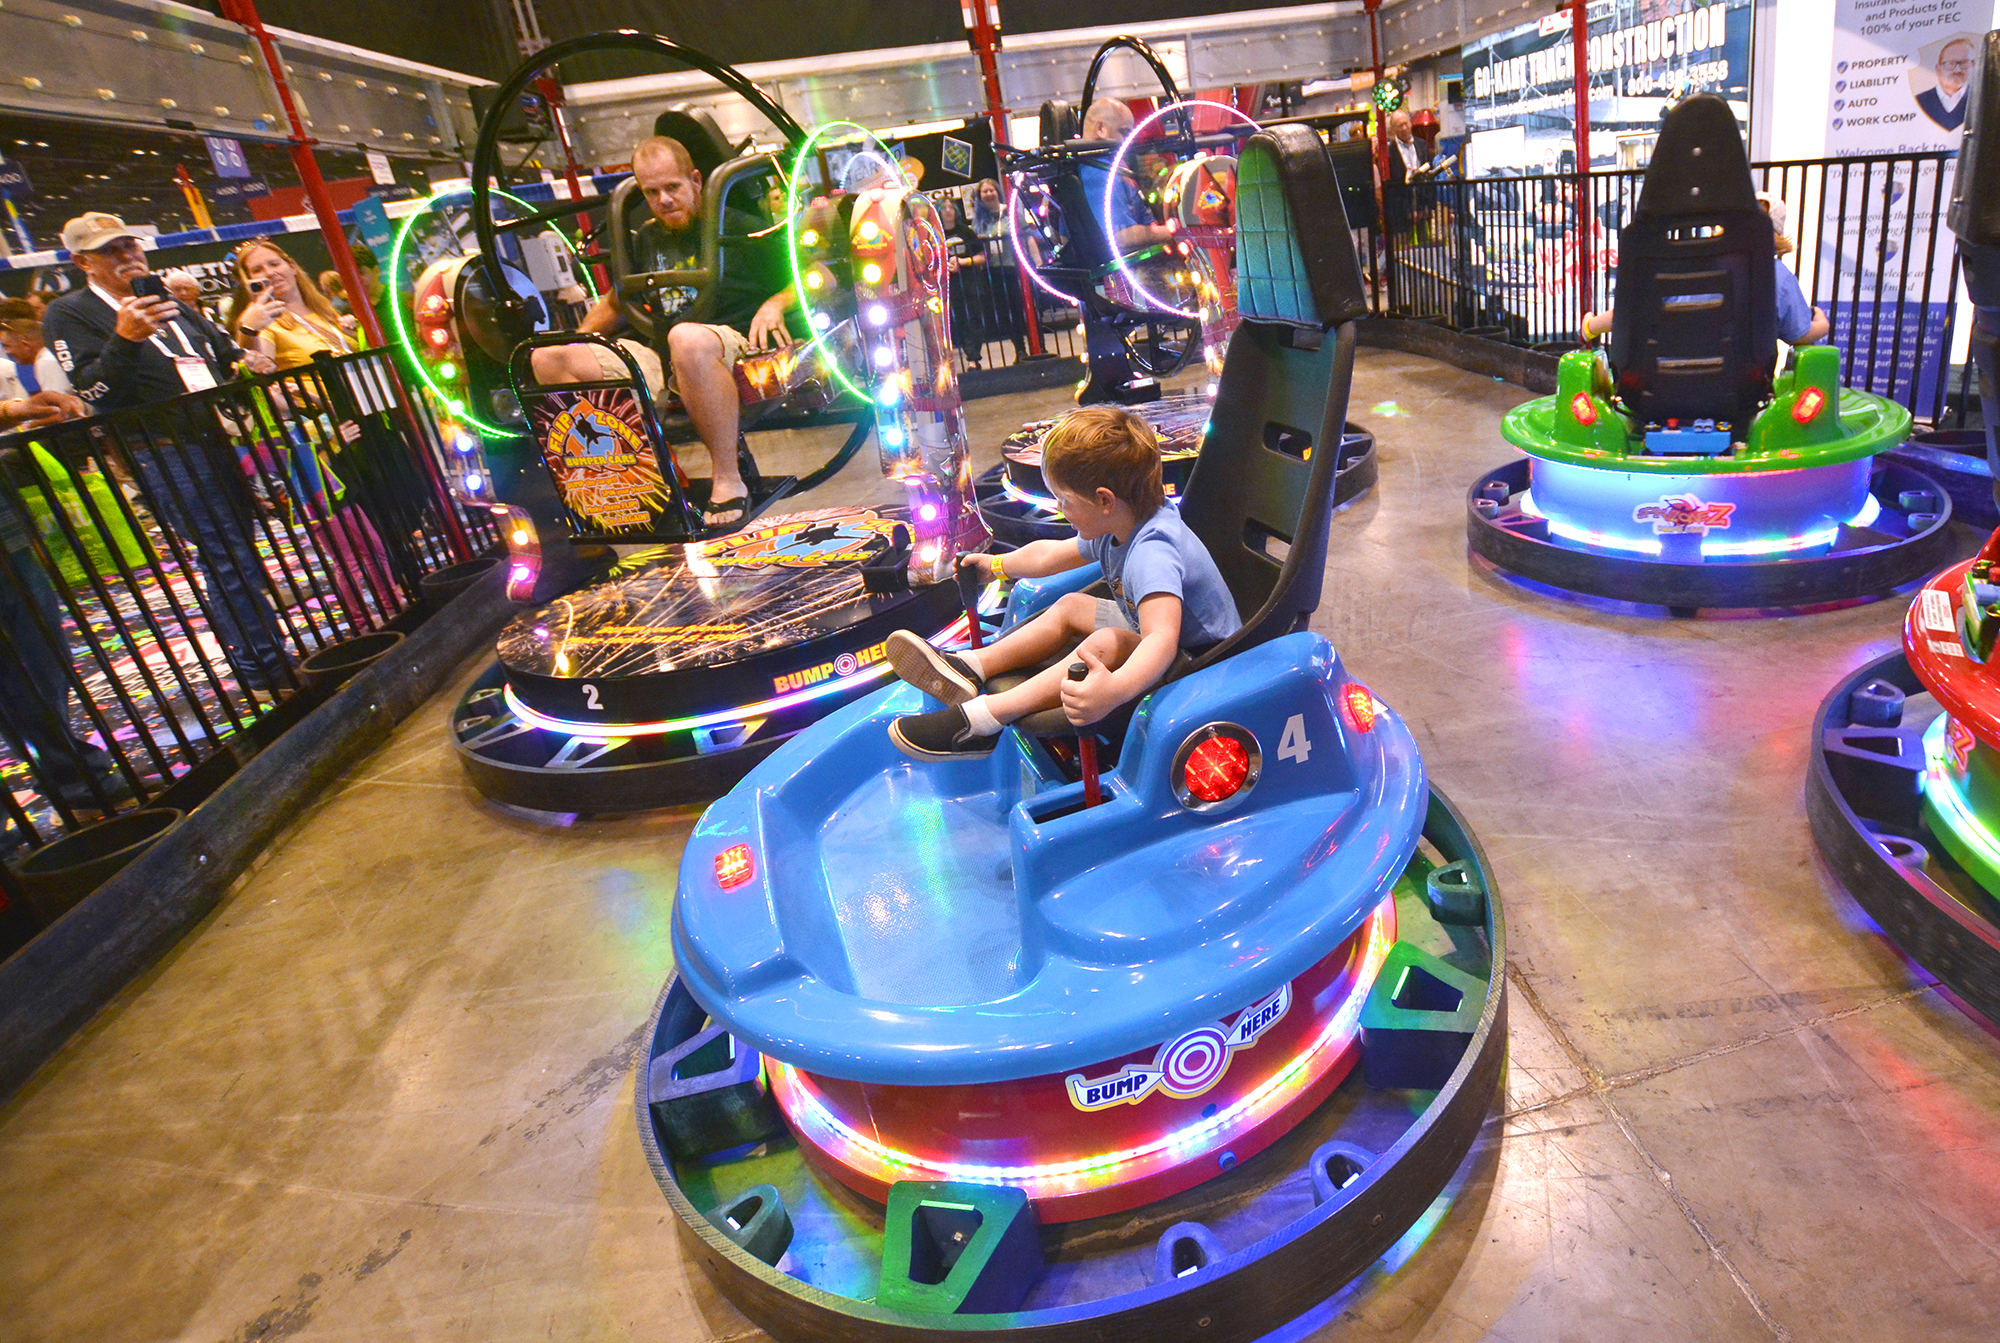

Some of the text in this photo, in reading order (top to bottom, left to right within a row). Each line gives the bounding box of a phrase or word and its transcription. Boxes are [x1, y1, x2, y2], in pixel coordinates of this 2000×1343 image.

[1860, 11, 1962, 36] 100% of your FEC
[1865, 0, 1957, 22] and Products for
[1474, 55, 1528, 98] GO-KART
[1587, 2, 1727, 73] ONSTRUCTION
[1851, 55, 1908, 70] PROPERTY
[1849, 76, 1899, 90] LIABILITY
[1847, 97, 1878, 109] AUTO
[1846, 112, 1917, 127] WORK COMP
[547, 410, 643, 456] FLIP ZONE
[565, 454, 636, 467] BUMPER CARS
[700, 519, 916, 556] FLIP ZO
[801, 552, 873, 562] CARS
[773, 641, 888, 694] BUMP HE
[582, 684, 604, 710] 2
[1277, 713, 1312, 764] 4
[1087, 998, 1281, 1105] BUMP HERE
